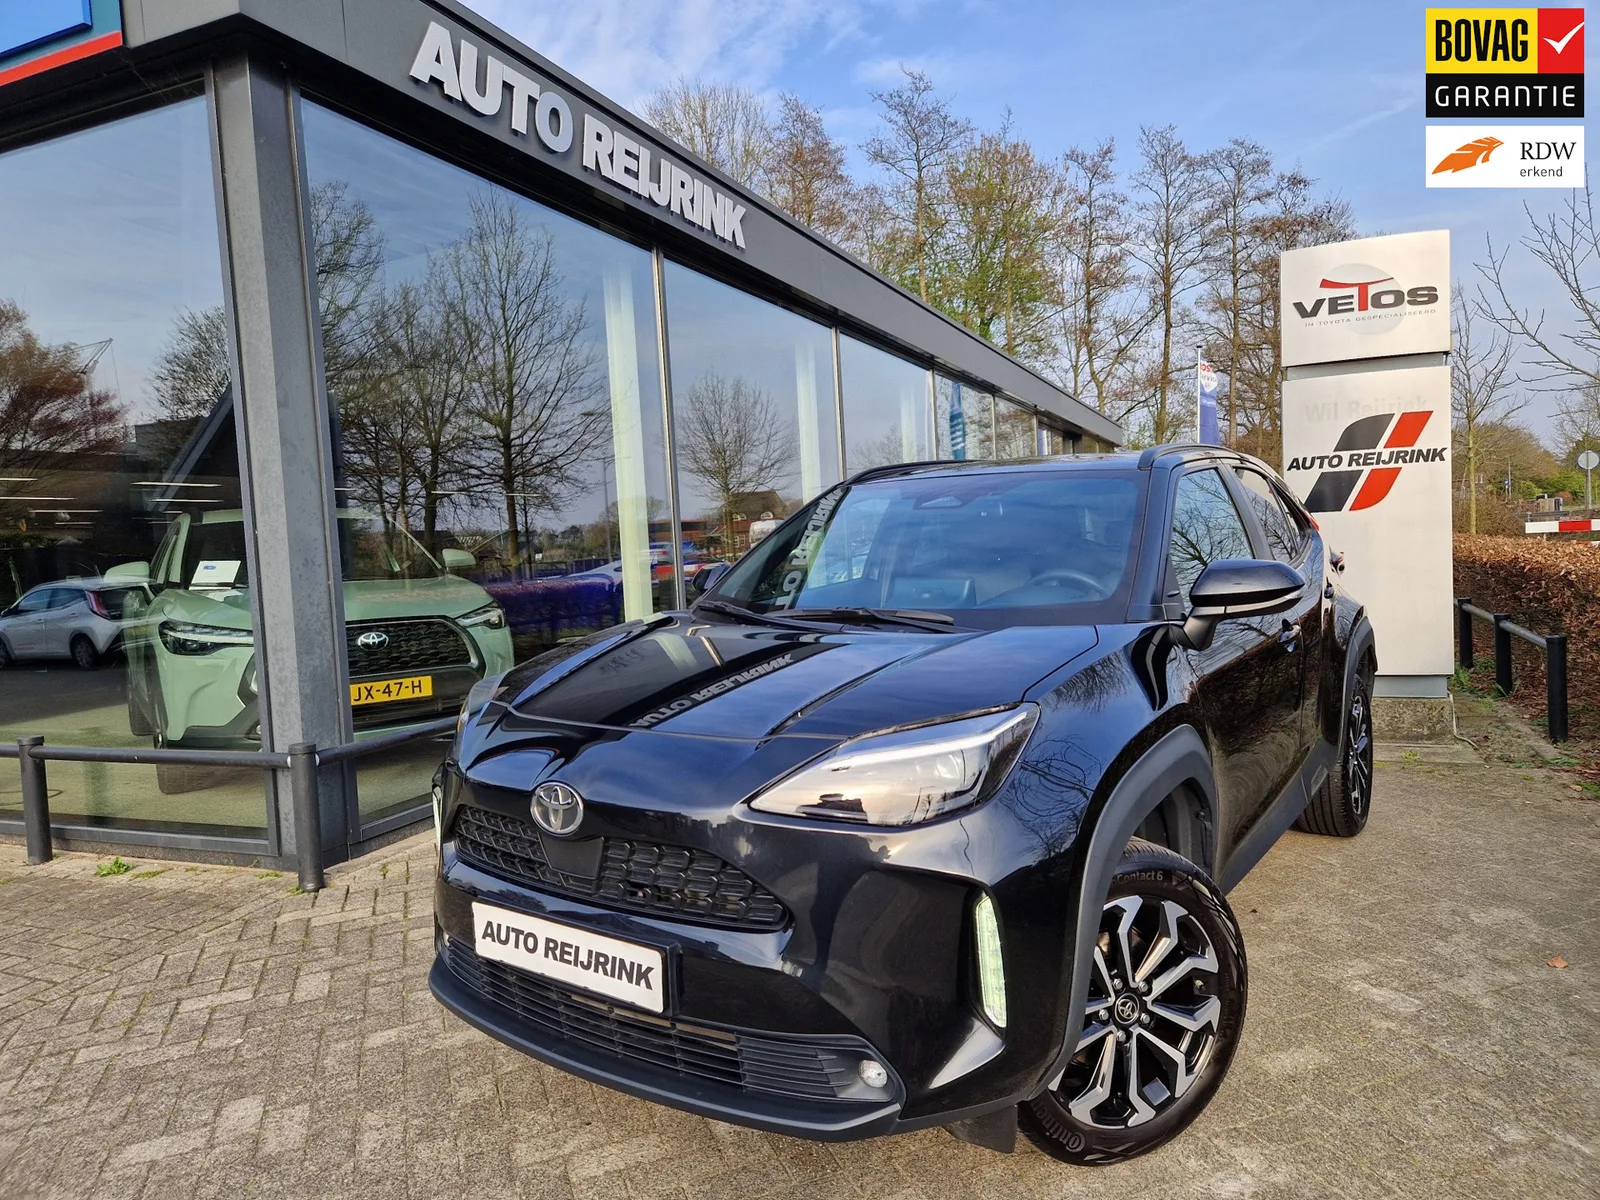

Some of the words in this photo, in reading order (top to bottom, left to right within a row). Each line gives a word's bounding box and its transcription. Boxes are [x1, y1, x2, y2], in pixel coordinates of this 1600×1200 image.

[409, 21, 573, 153] AUTO
[582, 113, 747, 250] REIJRINK
[1292, 277, 1439, 319] VETOS
[1318, 318, 1352, 326] TOYOTA
[1286, 454, 1343, 471] AUTO
[1347, 447, 1448, 467] REIJRINK
[481, 920, 539, 954] AUTO
[543, 937, 654, 990] REIJRINK
